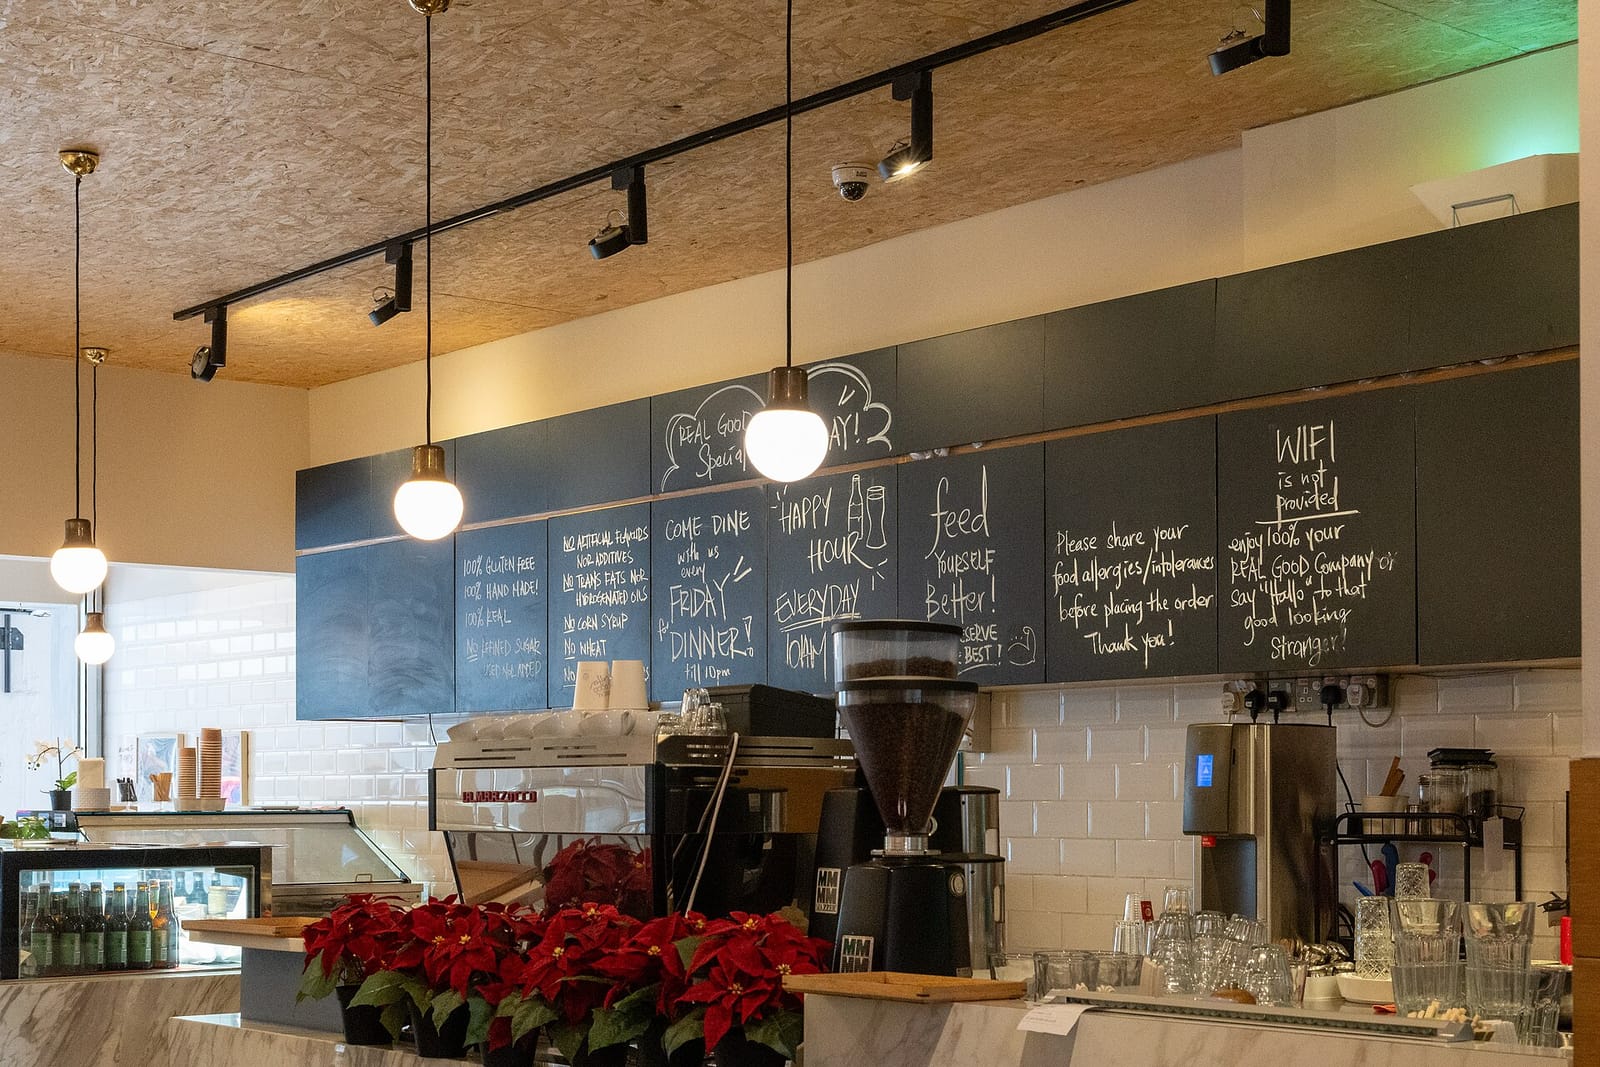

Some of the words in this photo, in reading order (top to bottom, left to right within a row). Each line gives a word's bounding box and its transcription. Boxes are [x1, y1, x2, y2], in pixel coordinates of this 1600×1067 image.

[679, 420, 711, 447] REAL
[829, 411, 860, 451] AY!
[1276, 419, 1336, 464] WIFI
[1278, 471, 1293, 490] is
[1301, 459, 1327, 488] not
[779, 487, 833, 535] HAPPY
[925, 464, 990, 560] feed
[1276, 476, 1339, 532] provided
[665, 516, 703, 541] COME
[711, 510, 751, 537] DINE
[1056, 530, 1098, 556] Please
[1106, 520, 1146, 551] share
[1153, 524, 1189, 553] your
[596, 550, 634, 567] ADDITIVES
[677, 541, 699, 566] with
[707, 545, 720, 559] us
[807, 531, 874, 575] HOUR
[1228, 531, 1264, 566] enjoy
[1267, 521, 1301, 549] 100%
[1305, 523, 1345, 551] your
[464, 555, 483, 577] 100%
[486, 556, 515, 575] GLUTEN
[517, 556, 536, 574] FREE
[576, 570, 602, 590] TRANS
[605, 570, 626, 589] FATS
[681, 562, 706, 584] every
[1052, 557, 1080, 598] food
[1231, 557, 1267, 584] REAL
[1271, 554, 1309, 580] GOOD
[464, 581, 481, 601] 100%
[486, 583, 509, 600] HAND
[512, 579, 539, 597] MADE!
[631, 585, 648, 603] OILS
[669, 573, 731, 624] FRIDAY
[773, 578, 861, 628] EVERYDAY
[1230, 588, 1257, 619] say
[1313, 572, 1332, 600] to
[1335, 569, 1368, 600] that
[465, 606, 484, 628] 100%
[486, 608, 512, 627] REAL
[577, 612, 599, 631] CORN
[601, 612, 629, 630] SYRUP
[1059, 592, 1098, 630] before
[1103, 591, 1143, 629] placing
[1146, 588, 1170, 612] the
[1174, 583, 1214, 611] order
[1243, 604, 1279, 647] good
[1287, 596, 1352, 627] looking
[657, 617, 670, 642] for
[960, 623, 998, 643] SERVE
[1083, 622, 1139, 655] Thank
[579, 637, 607, 657] WHEAT
[684, 663, 701, 685] till
[705, 665, 731, 686] 10pm
